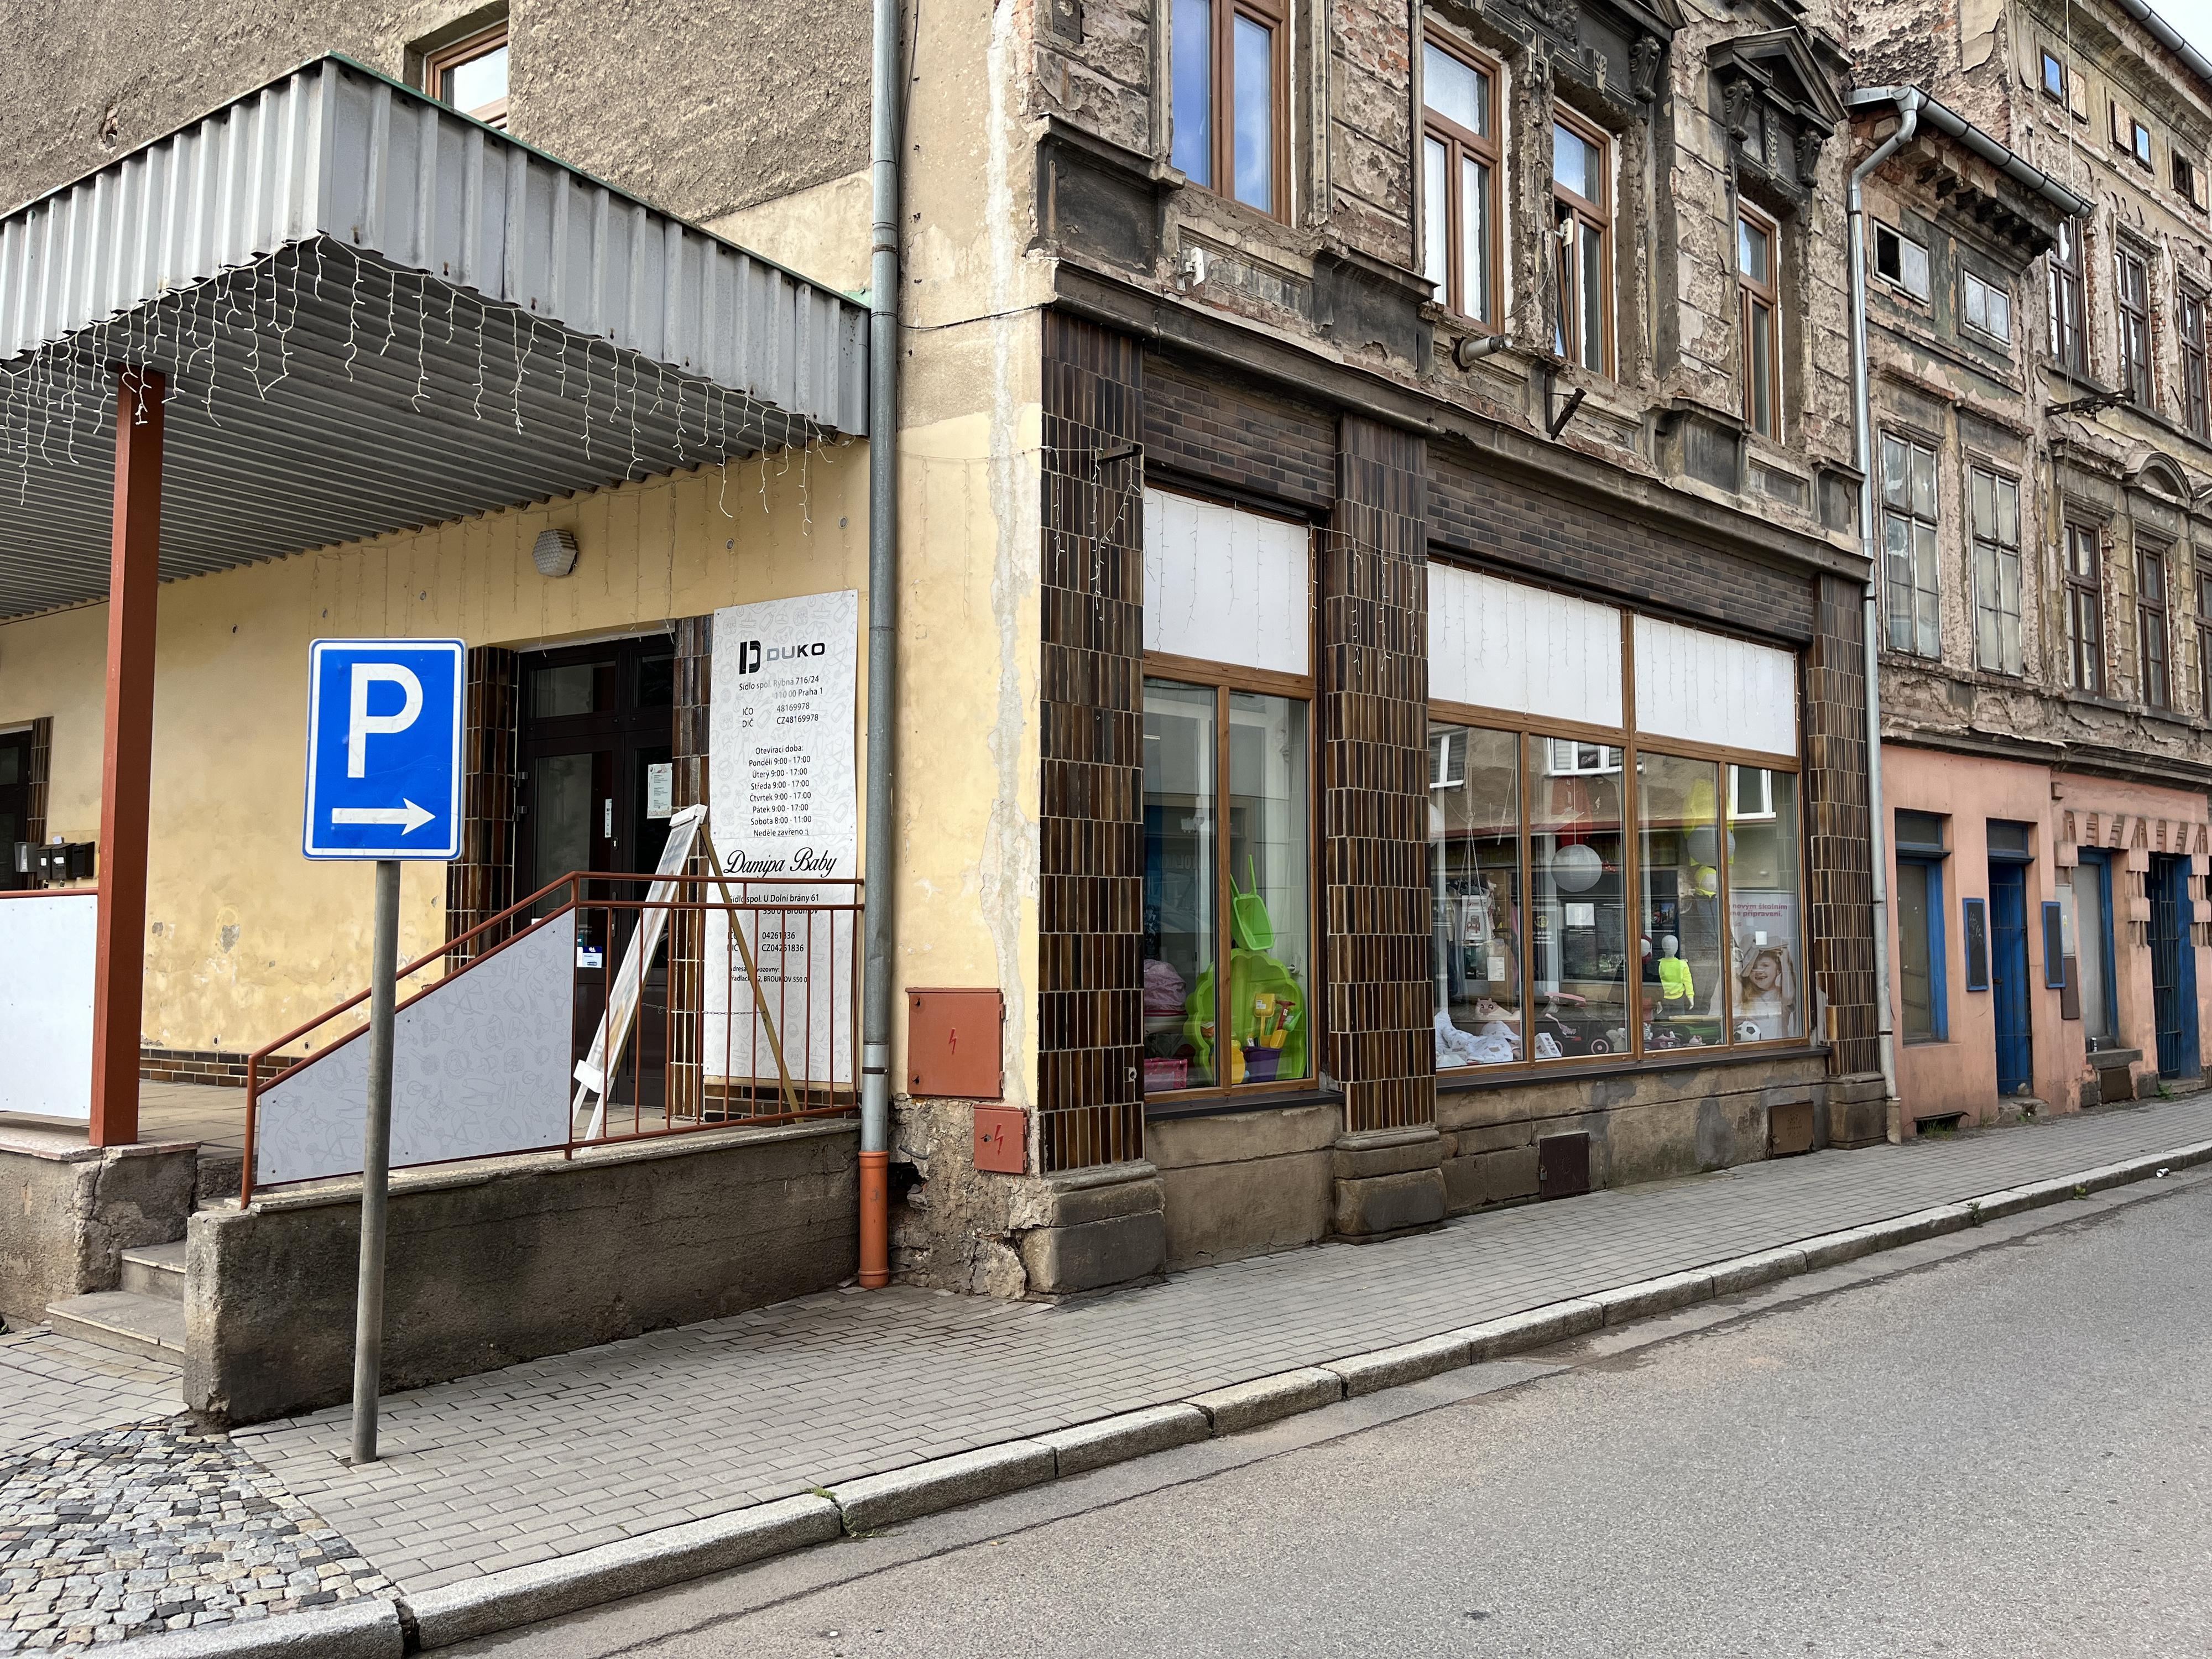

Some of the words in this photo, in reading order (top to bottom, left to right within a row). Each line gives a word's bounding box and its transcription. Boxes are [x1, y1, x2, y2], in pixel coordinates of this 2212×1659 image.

[767, 643, 825, 661] DUKO
[739, 682, 755, 691] Sídlo
[757, 682, 772, 691] spol.
[774, 679, 794, 688] Rybná
[796, 675, 820, 685] 716/24
[775, 691, 787, 699] 110
[789, 690, 796, 698] 00
[798, 688, 817, 697] Praha
[742, 706, 754, 716] IČO
[776, 702, 810, 712] 48169978
[347, 663, 423, 778] P
[742, 718, 754, 728] DIČ
[776, 713, 819, 724] CZ48169978
[755, 745, 784, 754] Otevírací
[785, 744, 804, 753] doba:
[774, 757, 787, 765] 9:00
[794, 755, 811, 764] 17:00
[752, 769, 770, 779] Úterý
[790, 768, 807, 776] 17:00
[750, 781, 771, 790] Středa
[773, 781, 786, 789] 9:00
[792, 779, 810, 787] 17:00
[749, 793, 773, 802] Čtvrtek
[774, 792, 788, 801] 9:00
[794, 791, 811, 800] 17:00
[753, 805, 770, 813] Pátek
[750, 817, 773, 826] Sobota
[794, 815, 812, 823] 11:00
[754, 828, 776, 837] Neděle
[778, 827, 804, 836] zavřeno
[723, 849, 786, 878] Damipa
[790, 847, 837, 878] Baby
[747, 894, 762, 904] spol.
[770, 894, 788, 902] Dolní
[790, 893, 810, 904] brány
